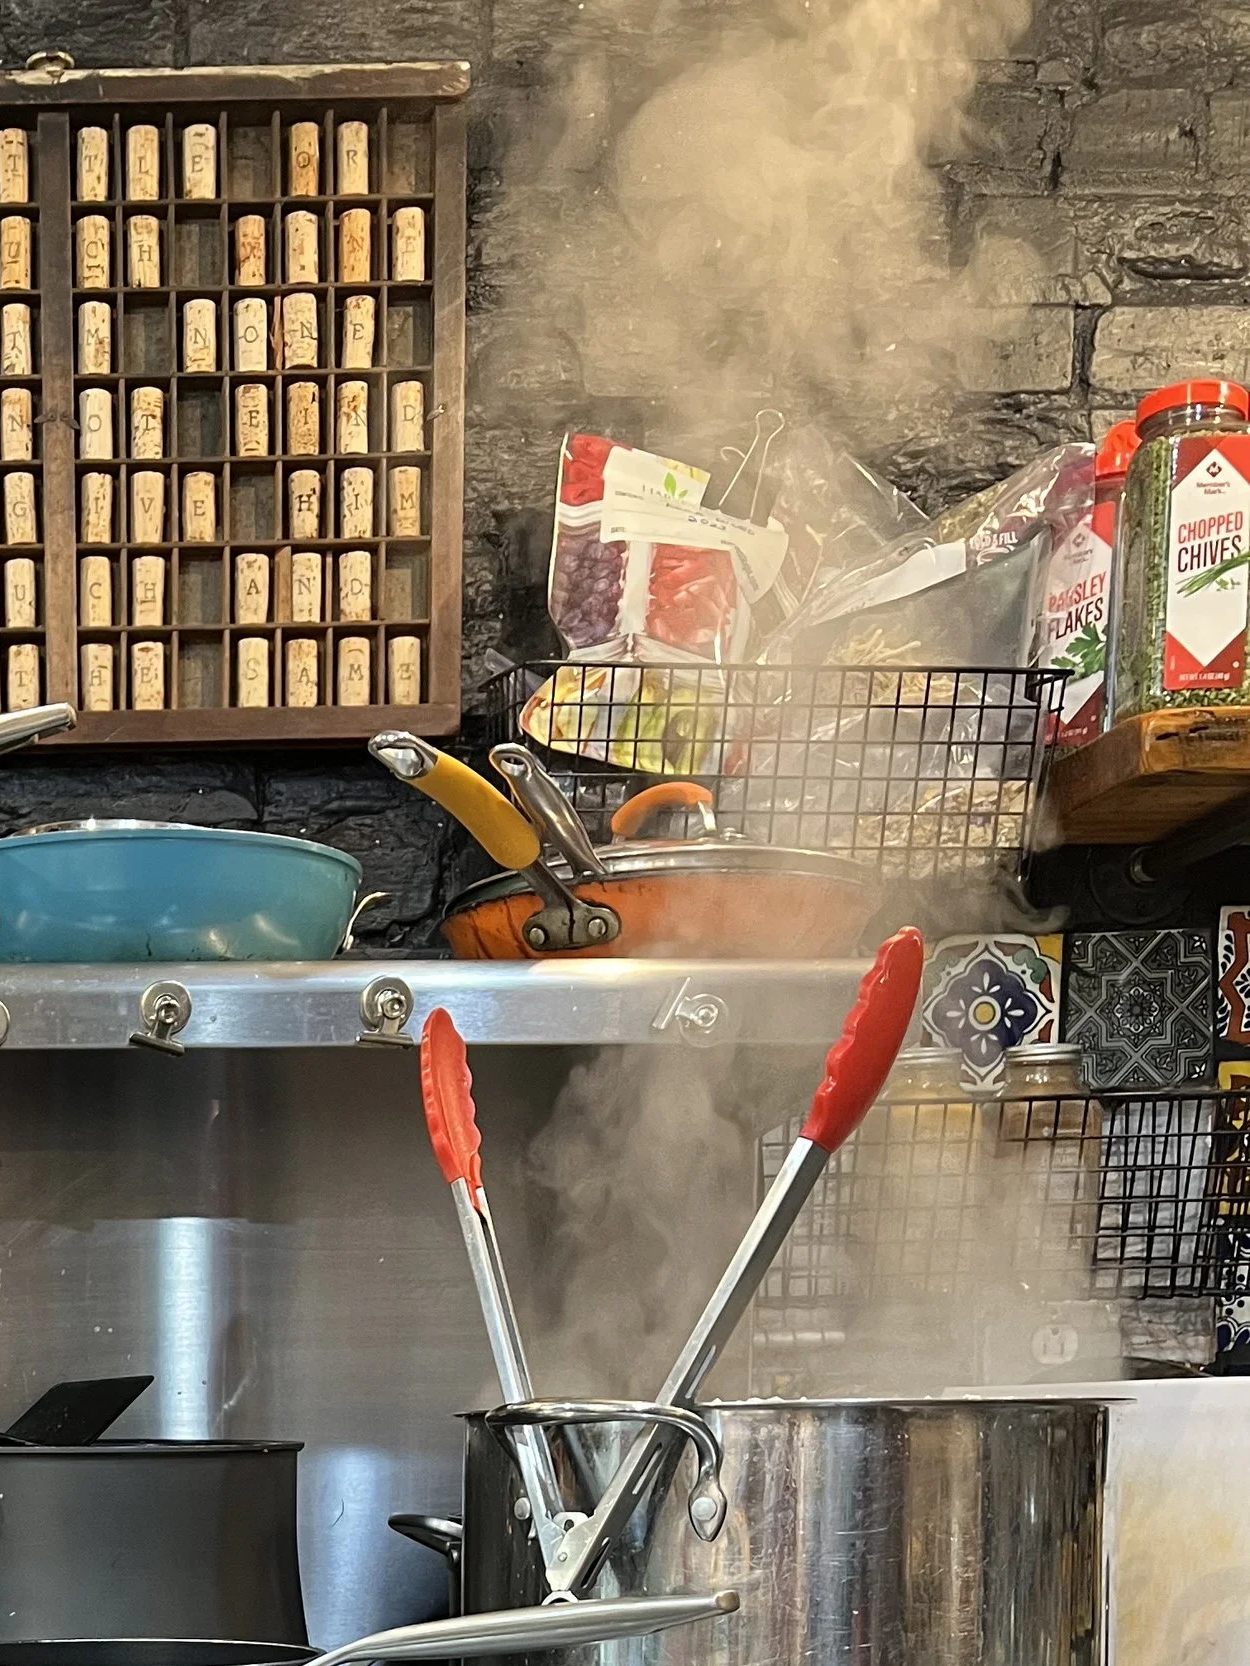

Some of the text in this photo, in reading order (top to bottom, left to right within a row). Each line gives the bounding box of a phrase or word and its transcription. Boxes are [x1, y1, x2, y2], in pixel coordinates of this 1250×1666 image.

[297, 148, 358, 169] OR
[193, 320, 364, 345] NONE
[11, 495, 206, 518] GIVE
[297, 490, 414, 513] HIM
[1178, 510, 1243, 545] CHOPPED
[1177, 534, 1242, 573] CHIVES
[247, 576, 367, 597] AND
[1048, 571, 1107, 613] PARSLEY
[1047, 598, 1104, 640] FLAKES
[14, 667, 154, 688] THE
[246, 658, 413, 684] SAME
